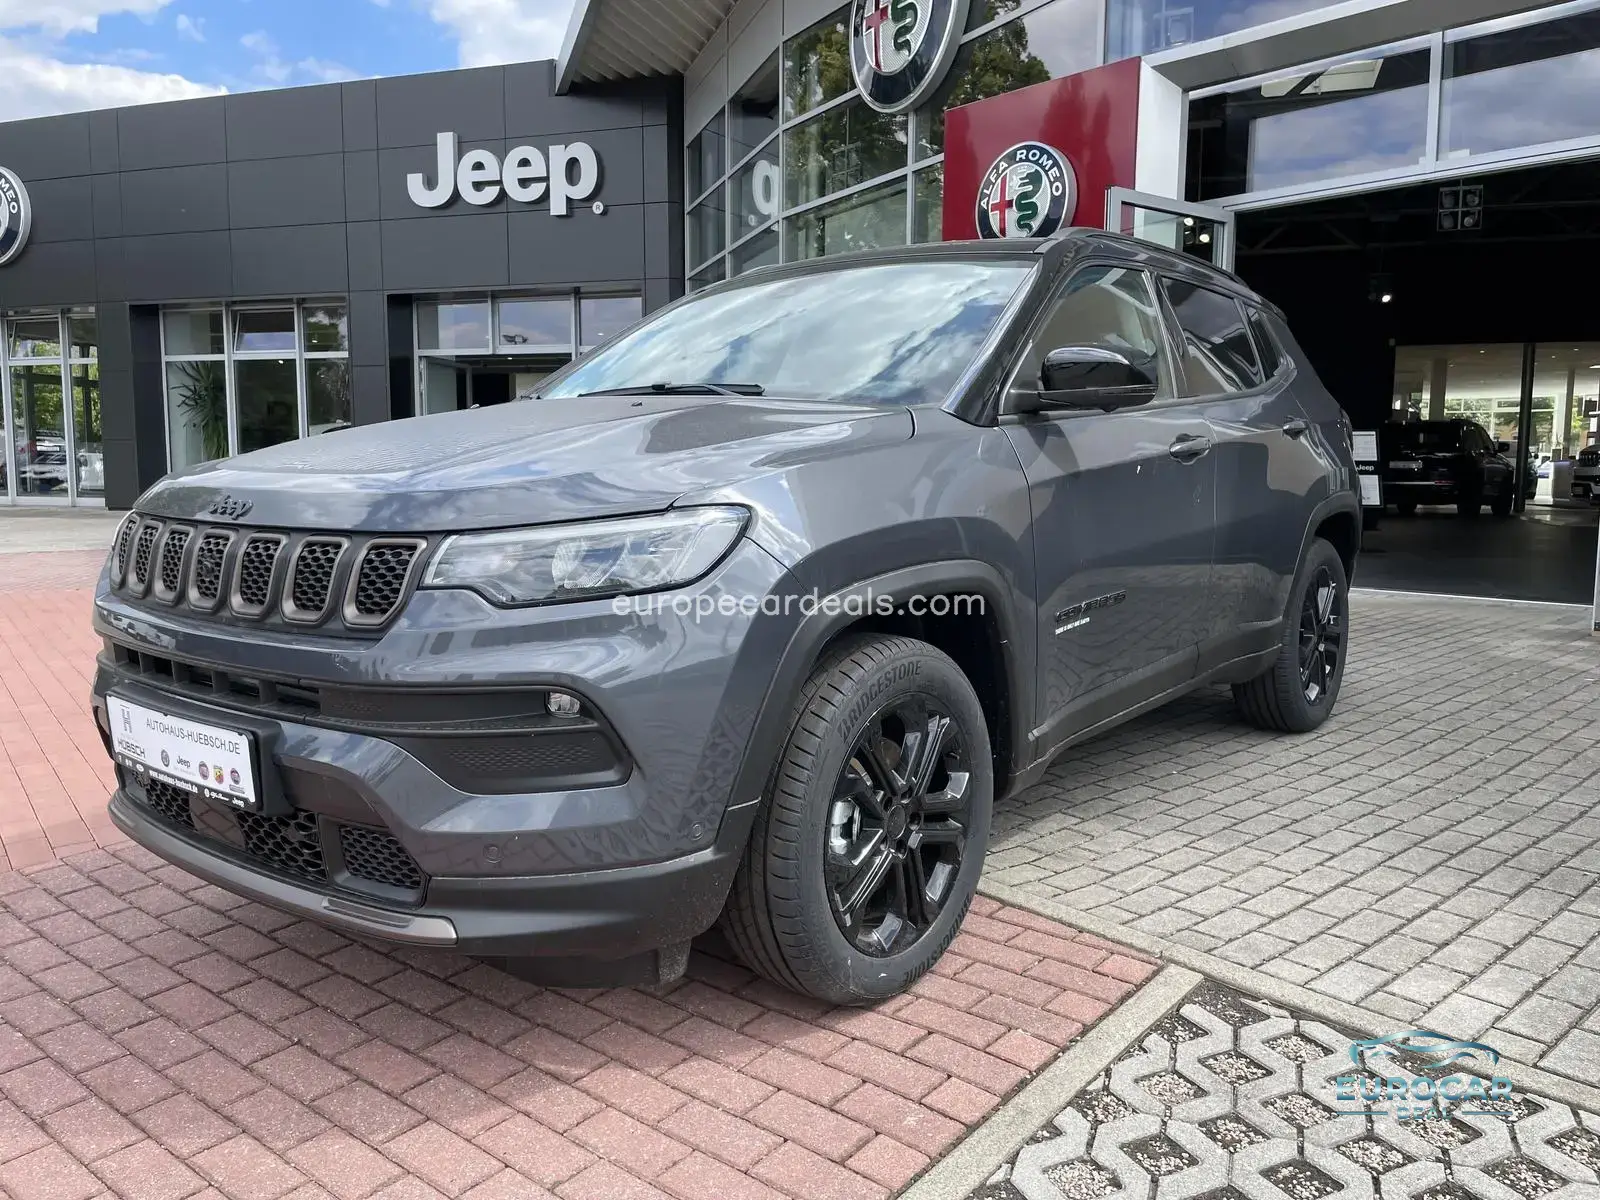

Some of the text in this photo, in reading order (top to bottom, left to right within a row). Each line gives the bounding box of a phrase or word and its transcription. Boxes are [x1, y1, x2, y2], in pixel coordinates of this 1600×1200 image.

[406, 131, 598, 216] Jeep
[980, 149, 1063, 210] ALFA ROMEO
[0, 177, 18, 214] MEO
[1356, 463, 1375, 472] Jeep
[207, 494, 254, 521] Jeep
[837, 659, 922, 744] BRIDGESTONE
[145, 717, 241, 755] AUTOHAUS-HUEBSCH.DE
[176, 755, 191, 768] Jeep
